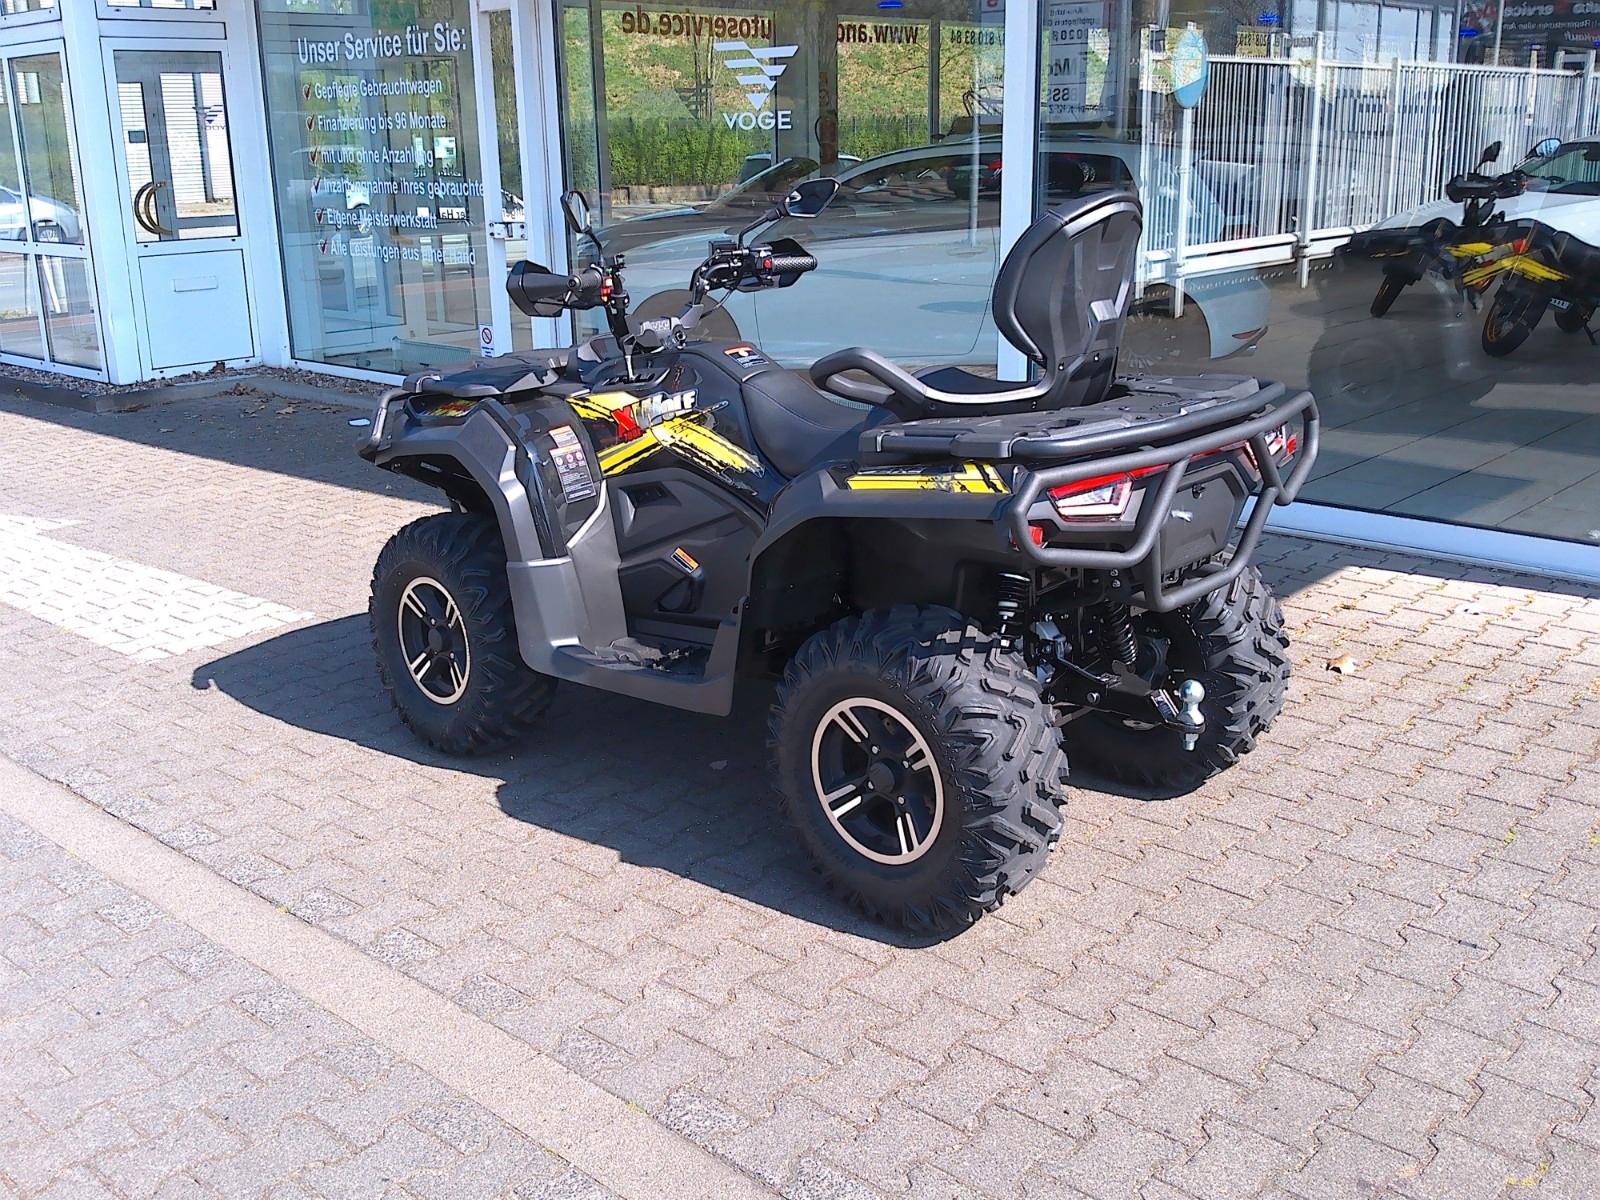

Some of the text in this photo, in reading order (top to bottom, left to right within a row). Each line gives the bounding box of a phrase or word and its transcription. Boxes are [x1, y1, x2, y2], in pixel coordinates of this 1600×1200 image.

[297, 22, 467, 64] Unser Service für Sie:
[314, 77, 443, 102] Gepflegte Gebrauchtwagen
[317, 111, 447, 134] Finanzierung bis 96 Monate
[723, 110, 792, 131] VOGE
[321, 145, 434, 168] mit und ohne Anzahlung
[400, 177, 425, 195] ihres
[326, 207, 438, 230] Eigene Meisterwerkstatt
[331, 239, 348, 256] Alle
[350, 241, 400, 263] Leistungen
[402, 247, 420, 261] aus
